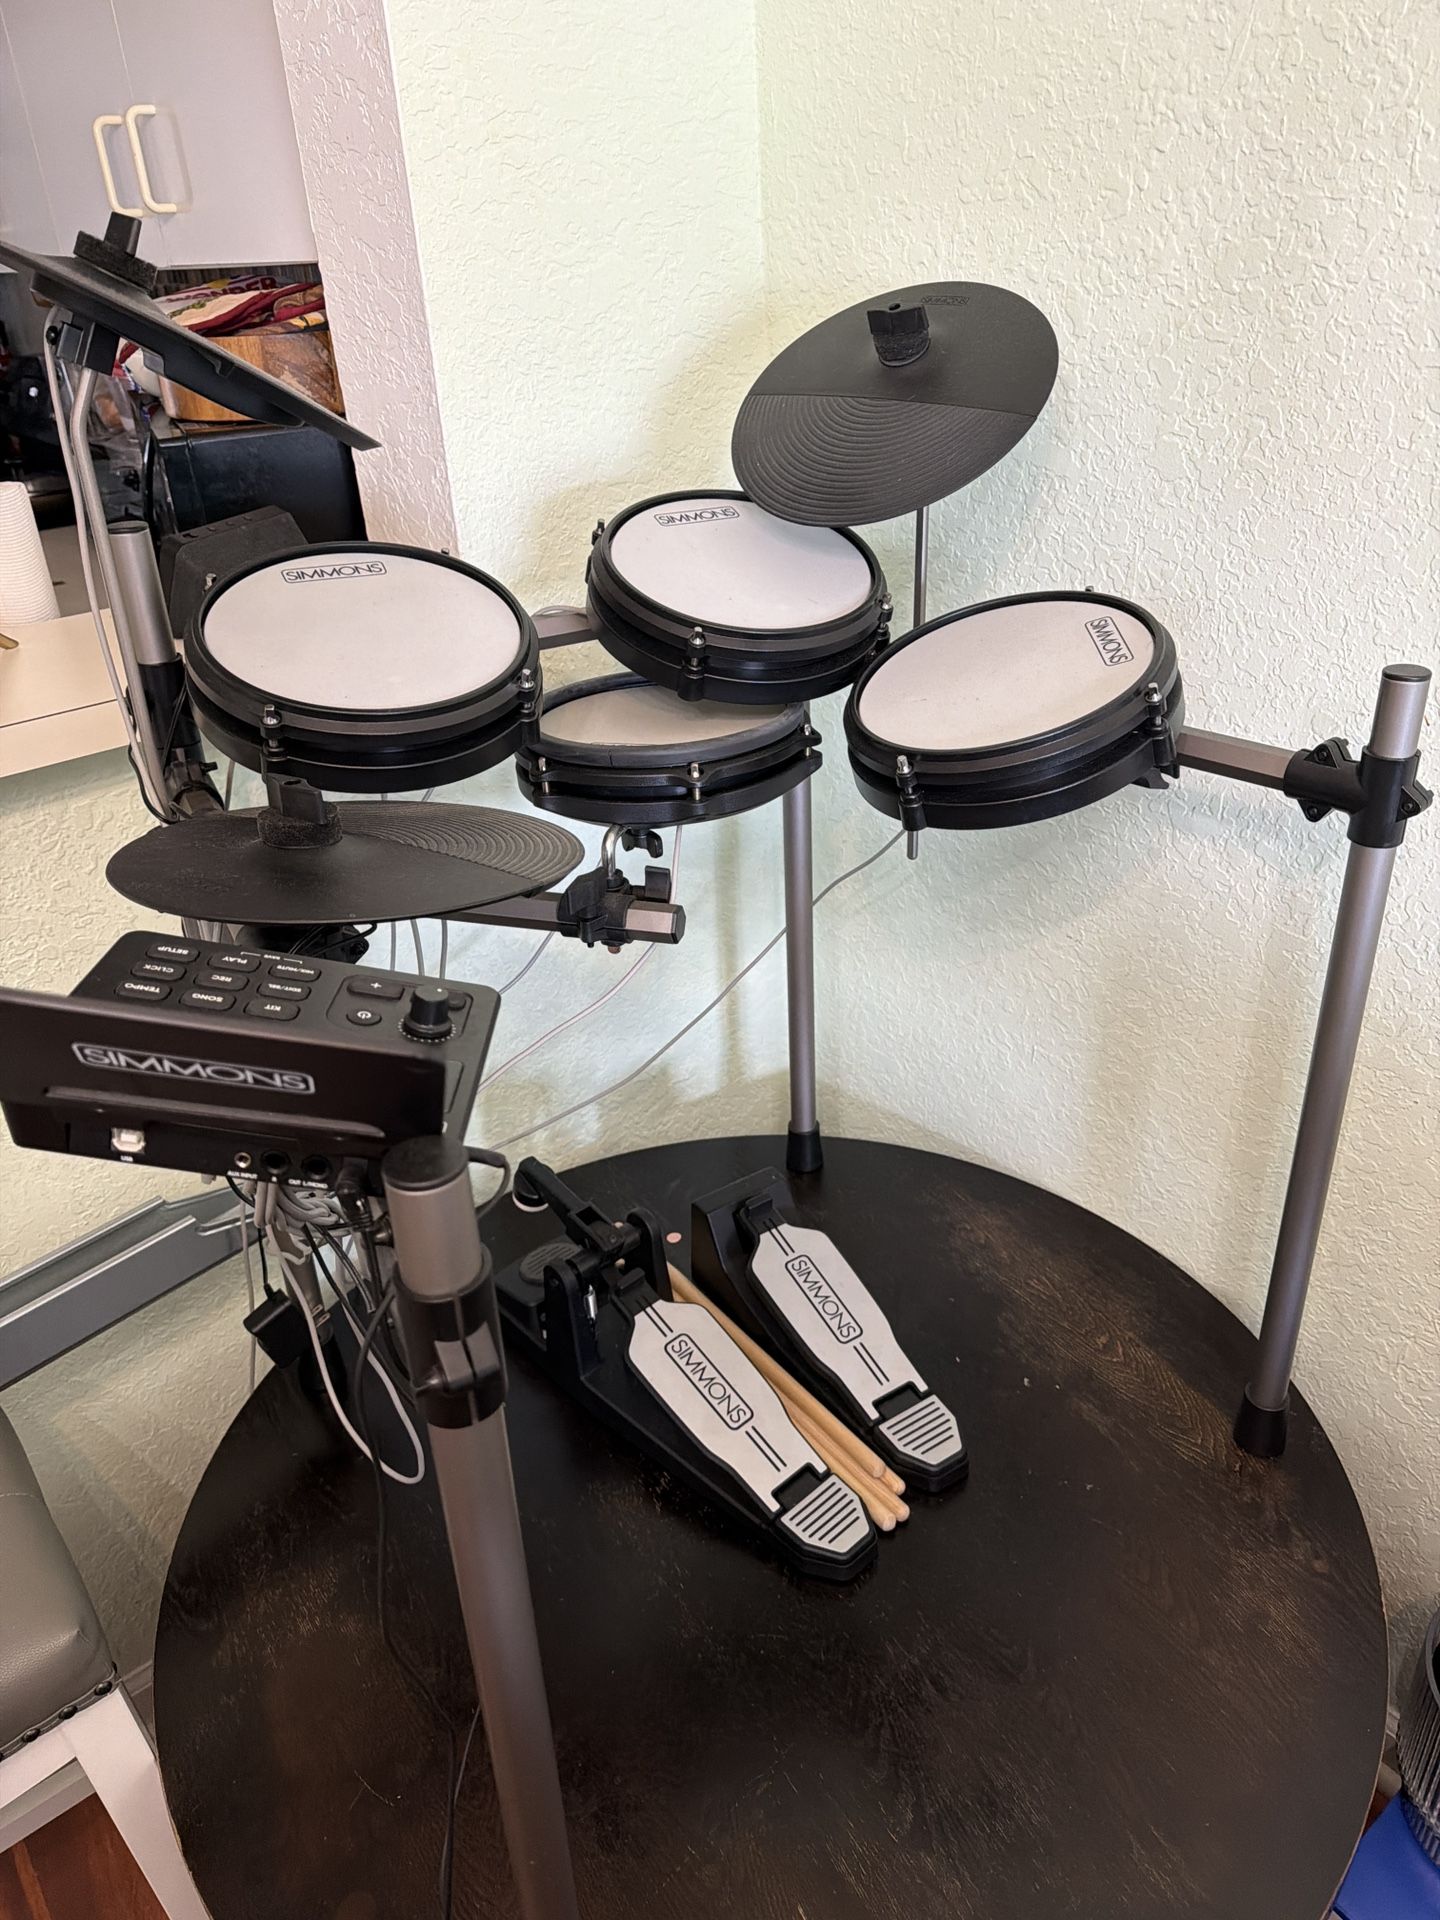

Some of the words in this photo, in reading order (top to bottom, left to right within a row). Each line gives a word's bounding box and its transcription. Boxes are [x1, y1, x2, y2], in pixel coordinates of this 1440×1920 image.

[658, 508, 736, 525] SIMMONS
[286, 563, 383, 581] SIMMONS
[1090, 618, 1129, 664] SIMMONS
[157, 945, 189, 955] SETUP
[222, 956, 248, 965] PLAY
[143, 964, 174, 973] CLICK
[211, 974, 232, 982] REC
[124, 982, 160, 994] TEMPO
[191, 992, 224, 1003] SONG
[264, 1003, 281, 1012] KIT
[83, 1047, 307, 1090] SIMMONS
[120, 1154, 134, 1162] USB
[240, 1171, 258, 1179] INPUT
[791, 1260, 856, 1338] SIMMONS
[671, 1339, 747, 1423] SIMMONS
